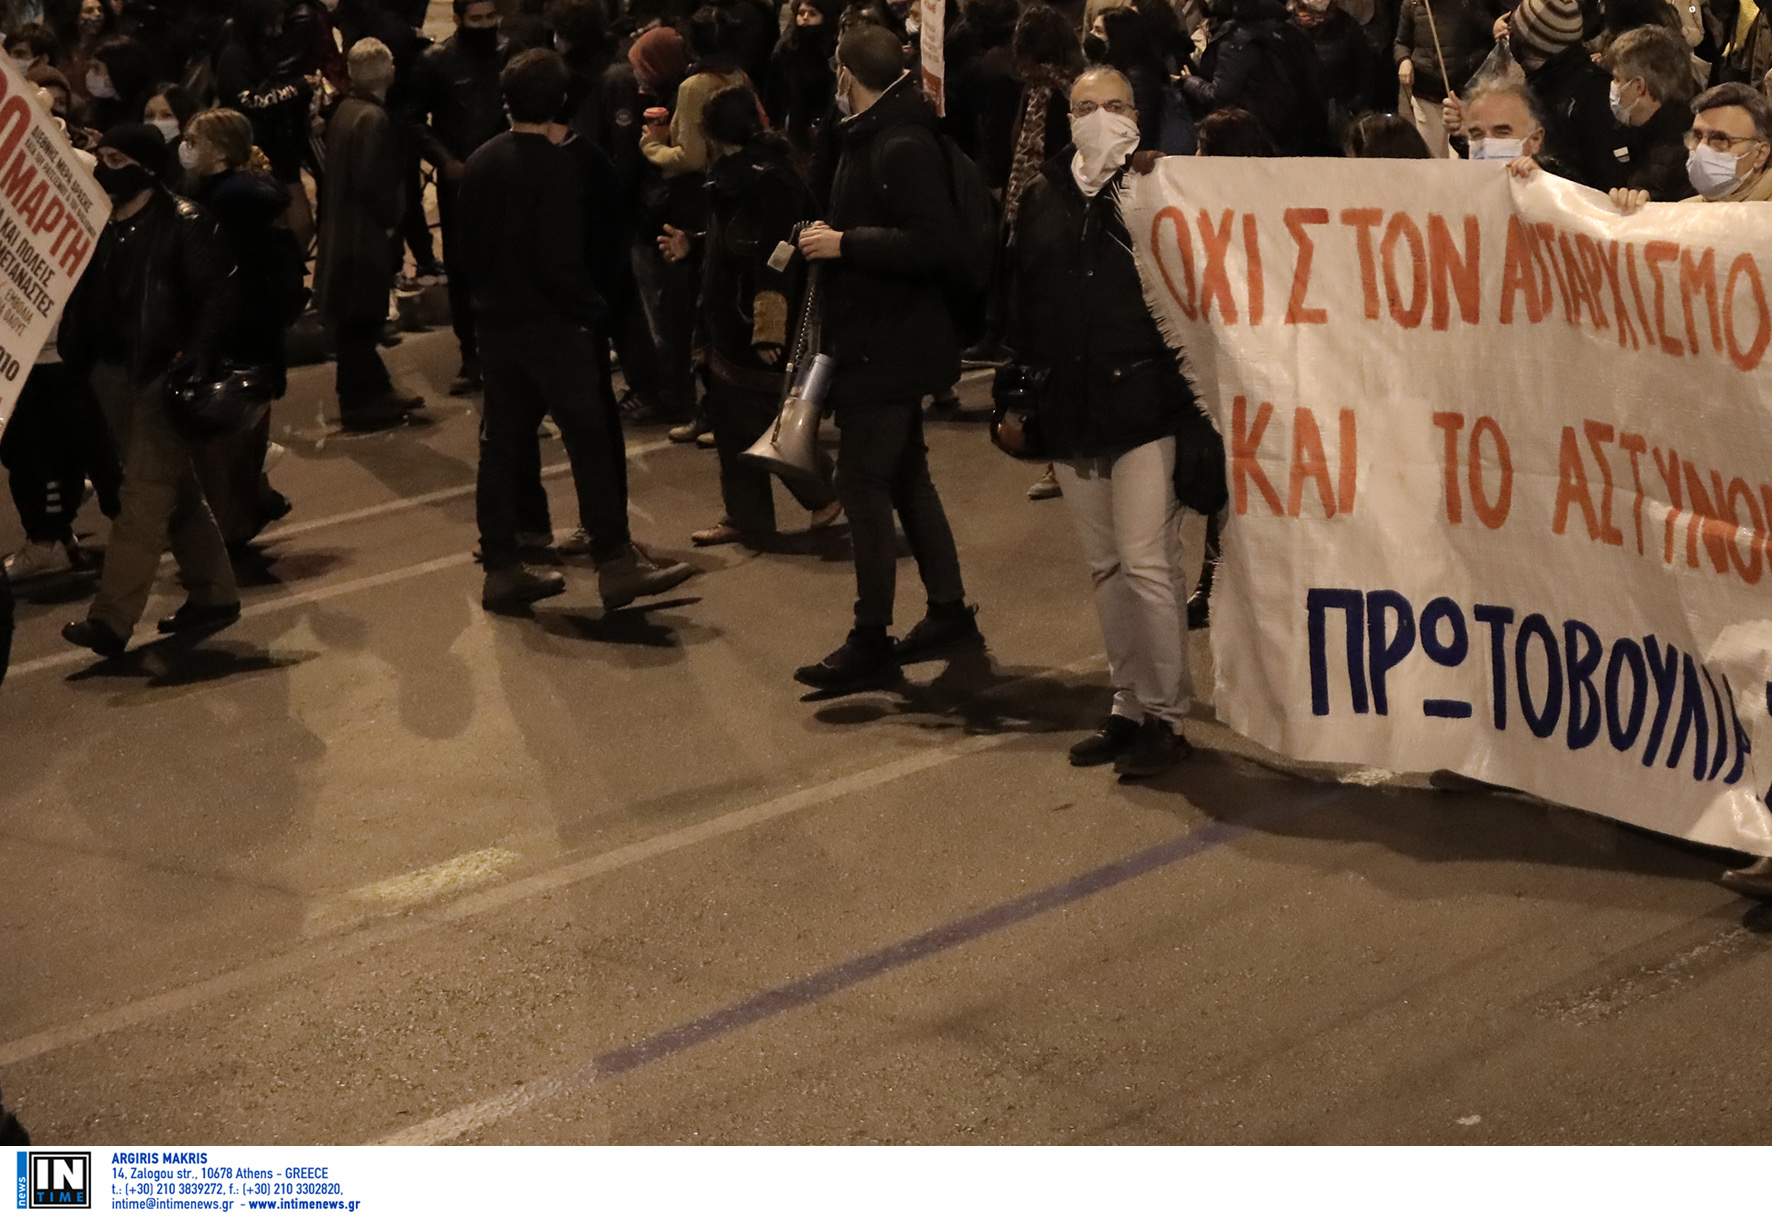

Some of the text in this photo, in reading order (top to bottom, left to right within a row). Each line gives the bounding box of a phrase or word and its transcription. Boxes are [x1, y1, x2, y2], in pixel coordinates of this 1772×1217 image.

[1, 149, 91, 278] ΜΑΡΤΗ
[56, 157, 74, 185] ΜΕΡΑ
[0, 216, 55, 288] ΚΑΙ ΠΟΛΕΙΣ
[1151, 205, 1265, 326] ΟΧΙ
[1283, 206, 1482, 332] ΣΤΟΝ
[1230, 395, 1358, 519] ΚΑΙ
[1432, 411, 1514, 530] ΤΟ
